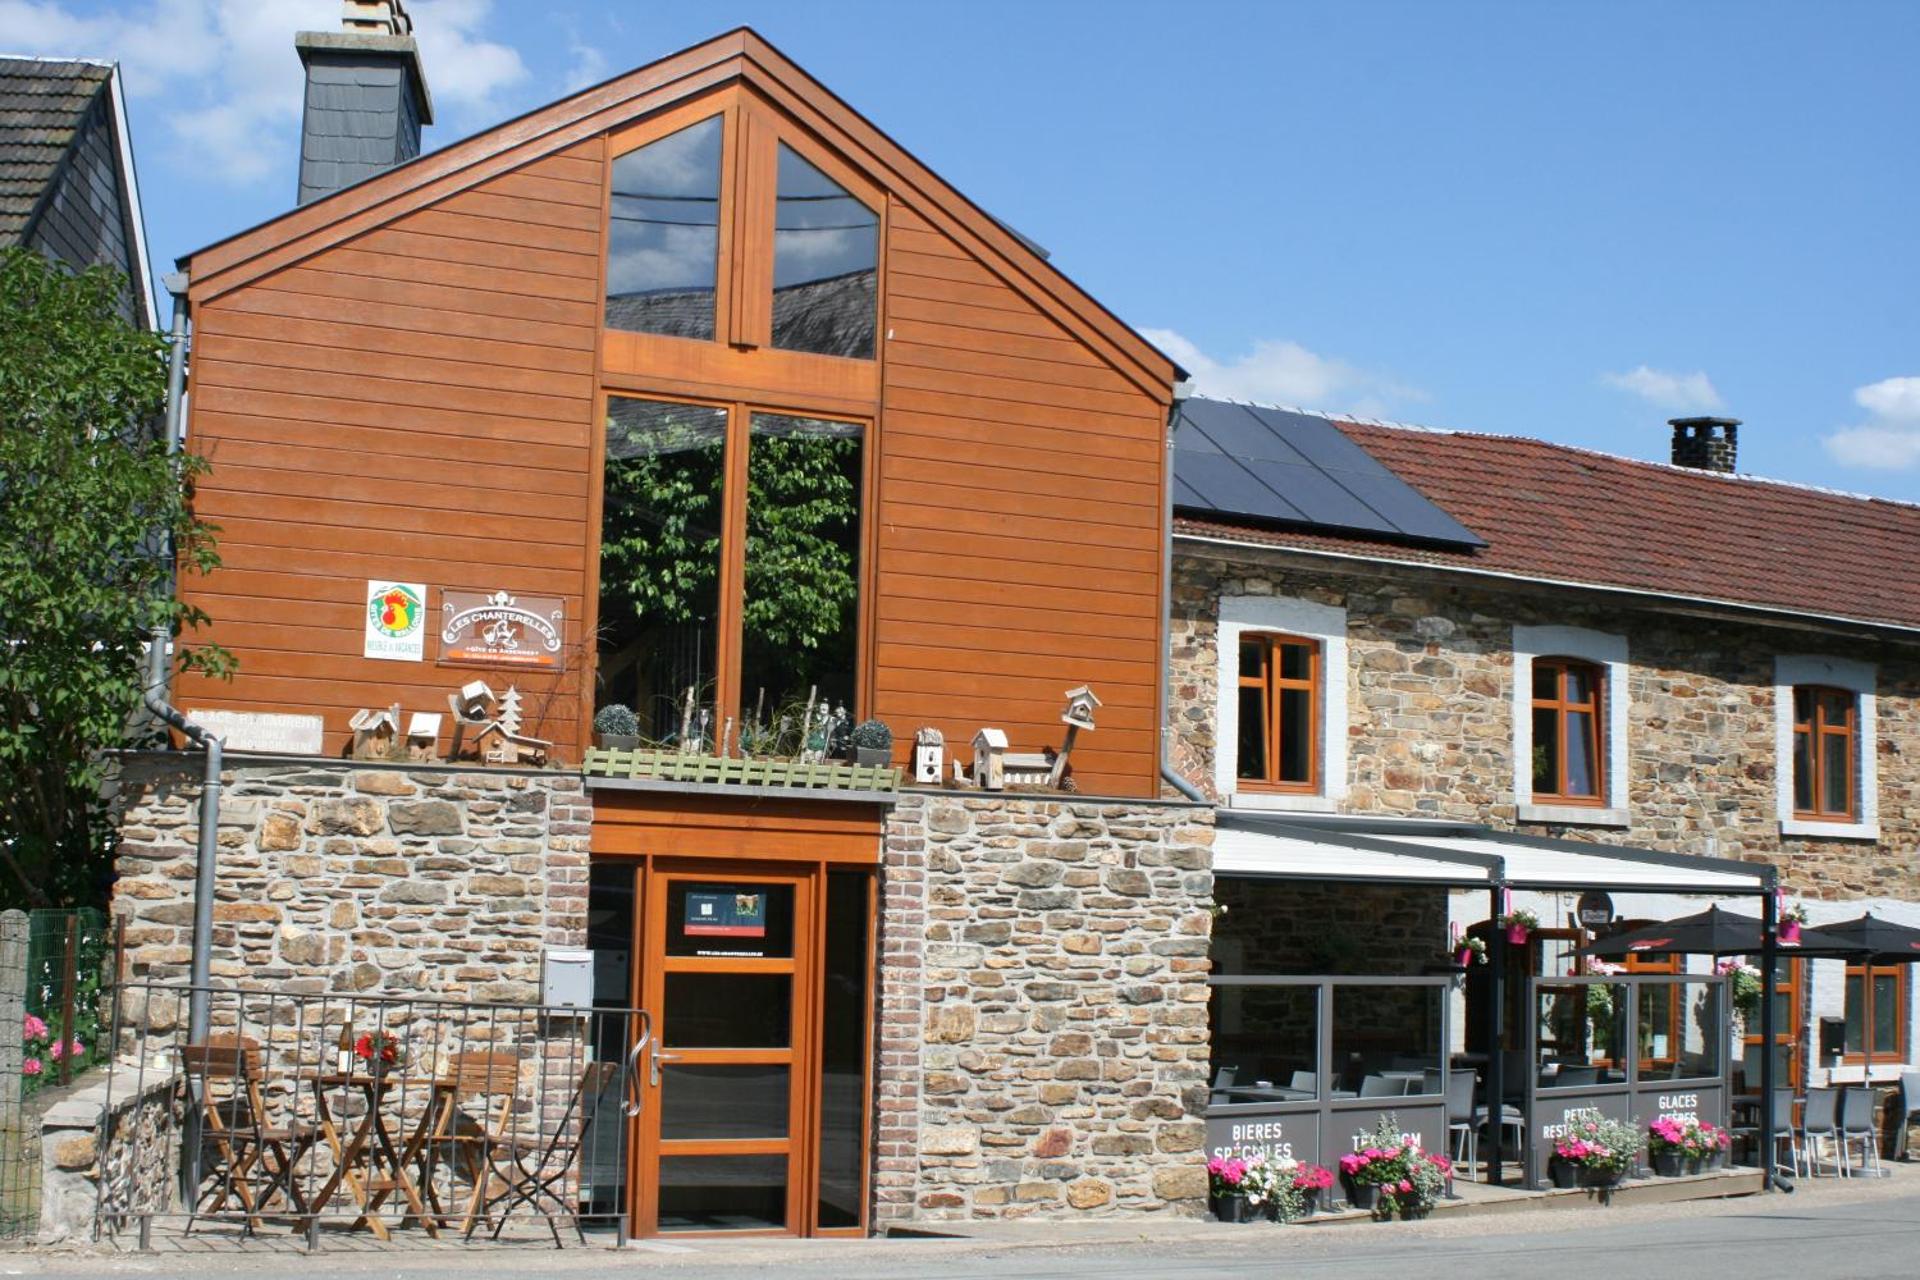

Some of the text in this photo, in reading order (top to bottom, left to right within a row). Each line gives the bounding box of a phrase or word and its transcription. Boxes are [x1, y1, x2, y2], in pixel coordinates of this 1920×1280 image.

[450, 611, 553, 640] LES CHANTERELLES
[1658, 1094, 1698, 1110] GLACES
[1232, 1122, 1282, 1141] BIERES
